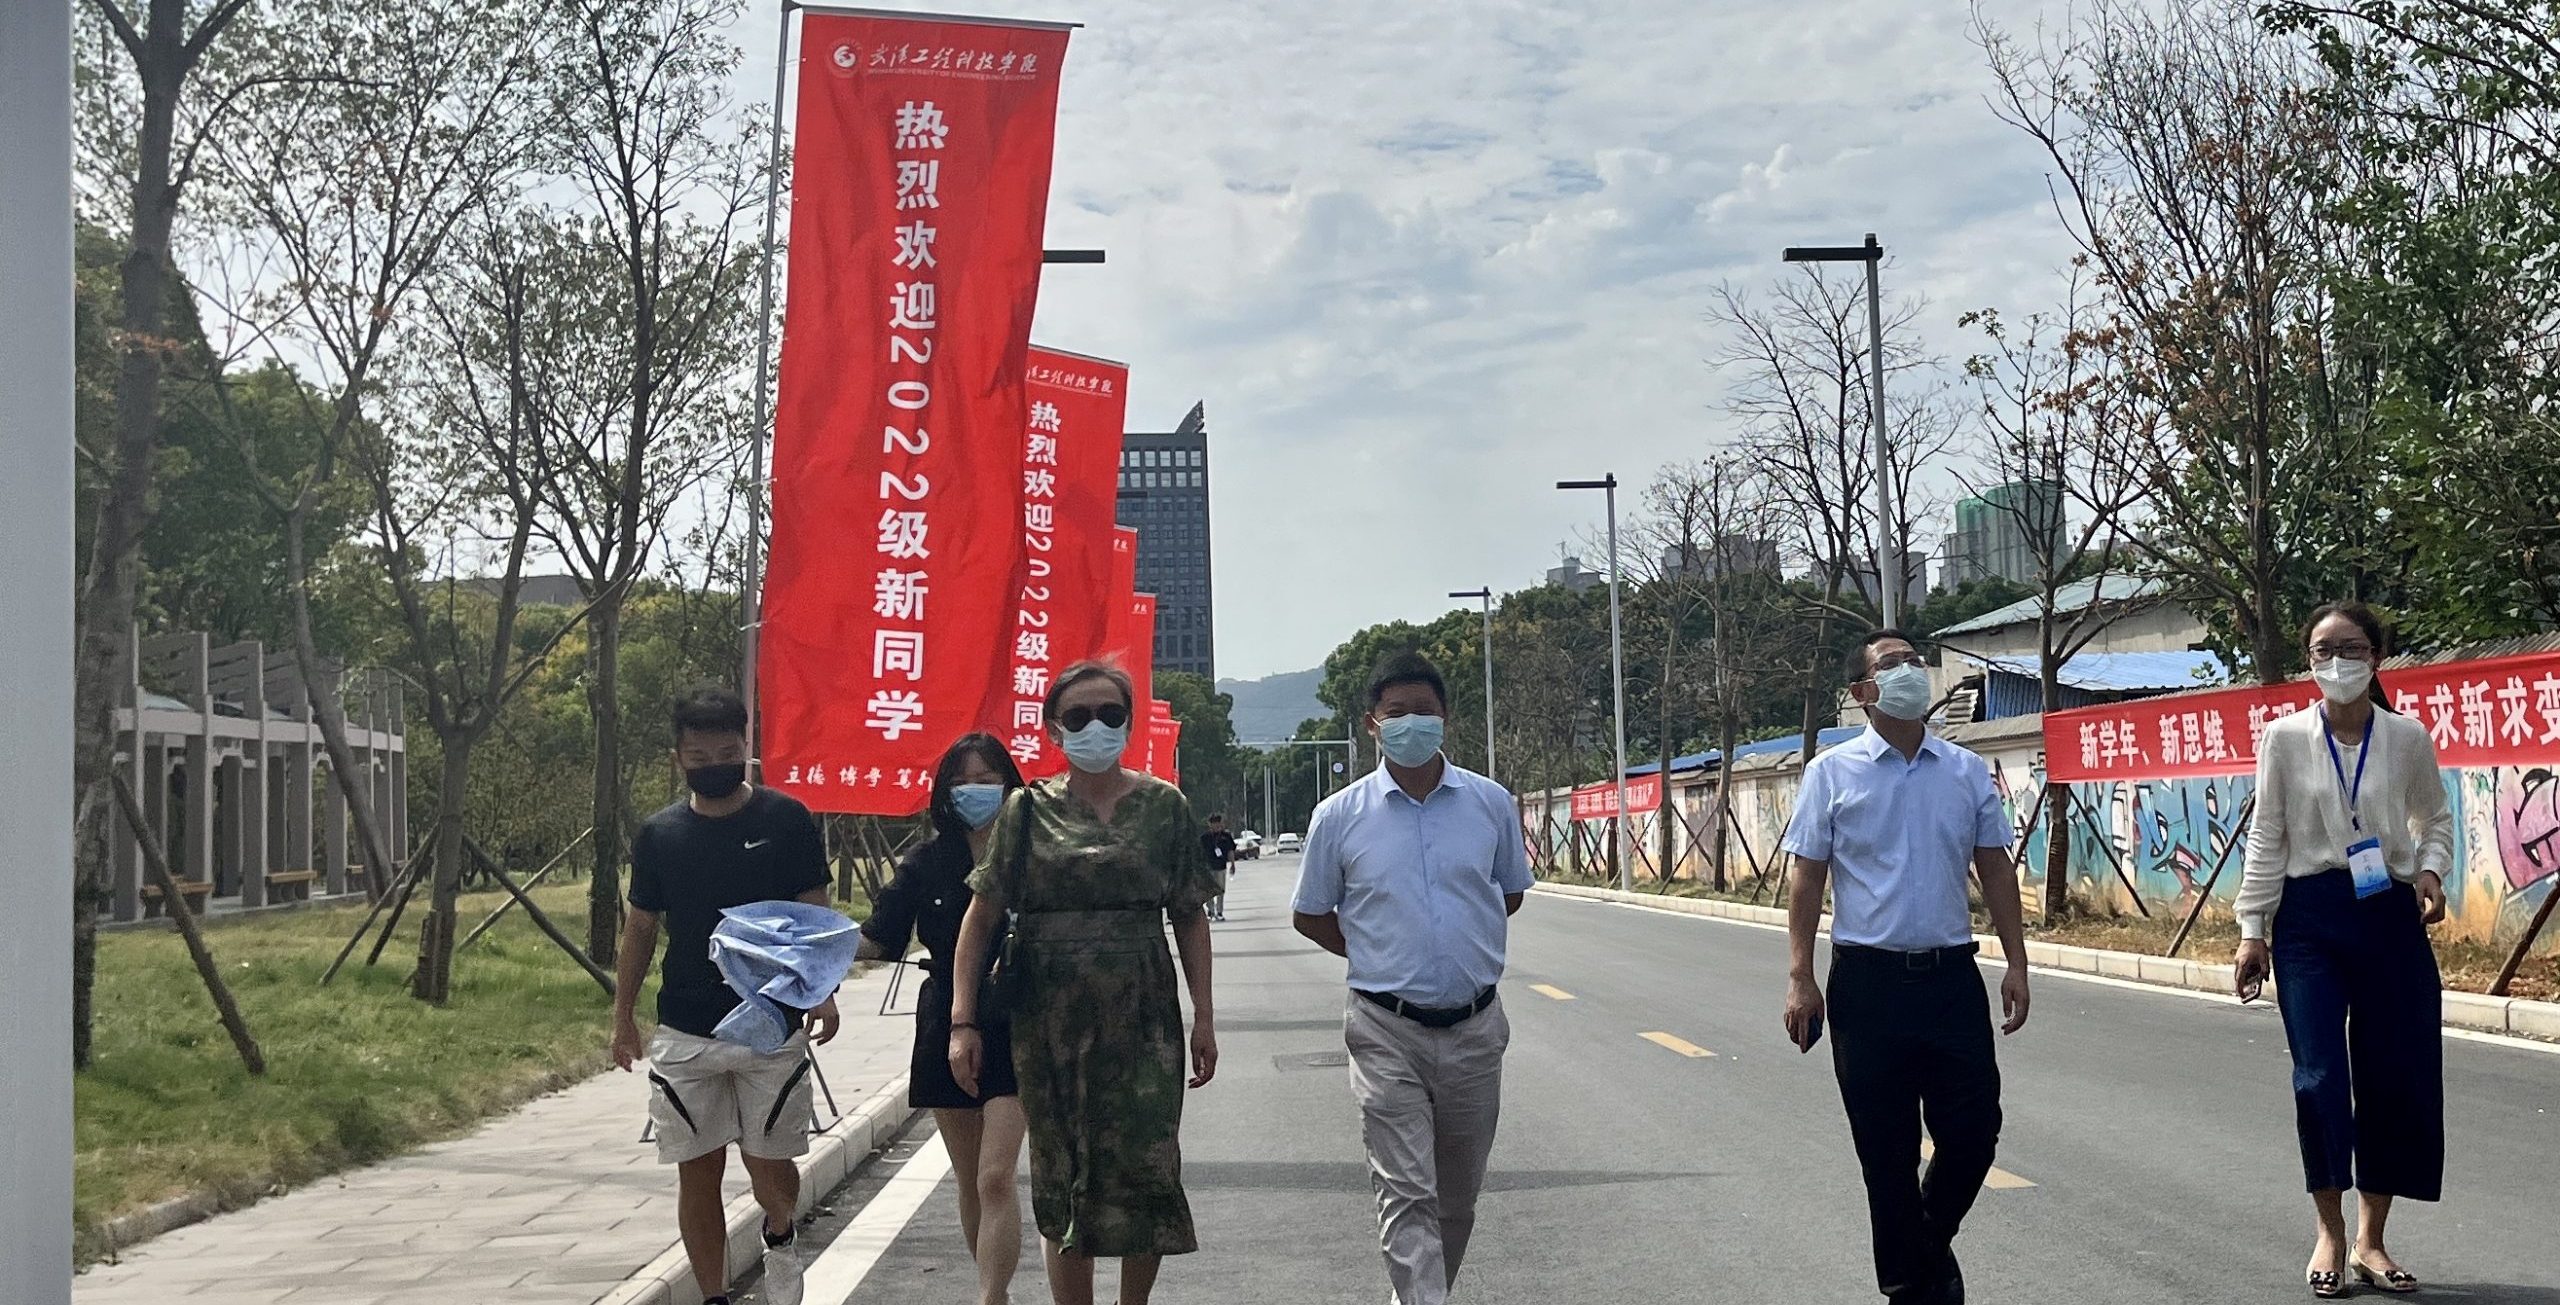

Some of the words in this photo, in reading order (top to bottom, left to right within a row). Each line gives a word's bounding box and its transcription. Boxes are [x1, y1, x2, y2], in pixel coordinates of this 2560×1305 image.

[865, 101, 948, 740] 热烈欢迎2022级新同学
[2079, 698, 2316, 769] 新学年、新思维、新
